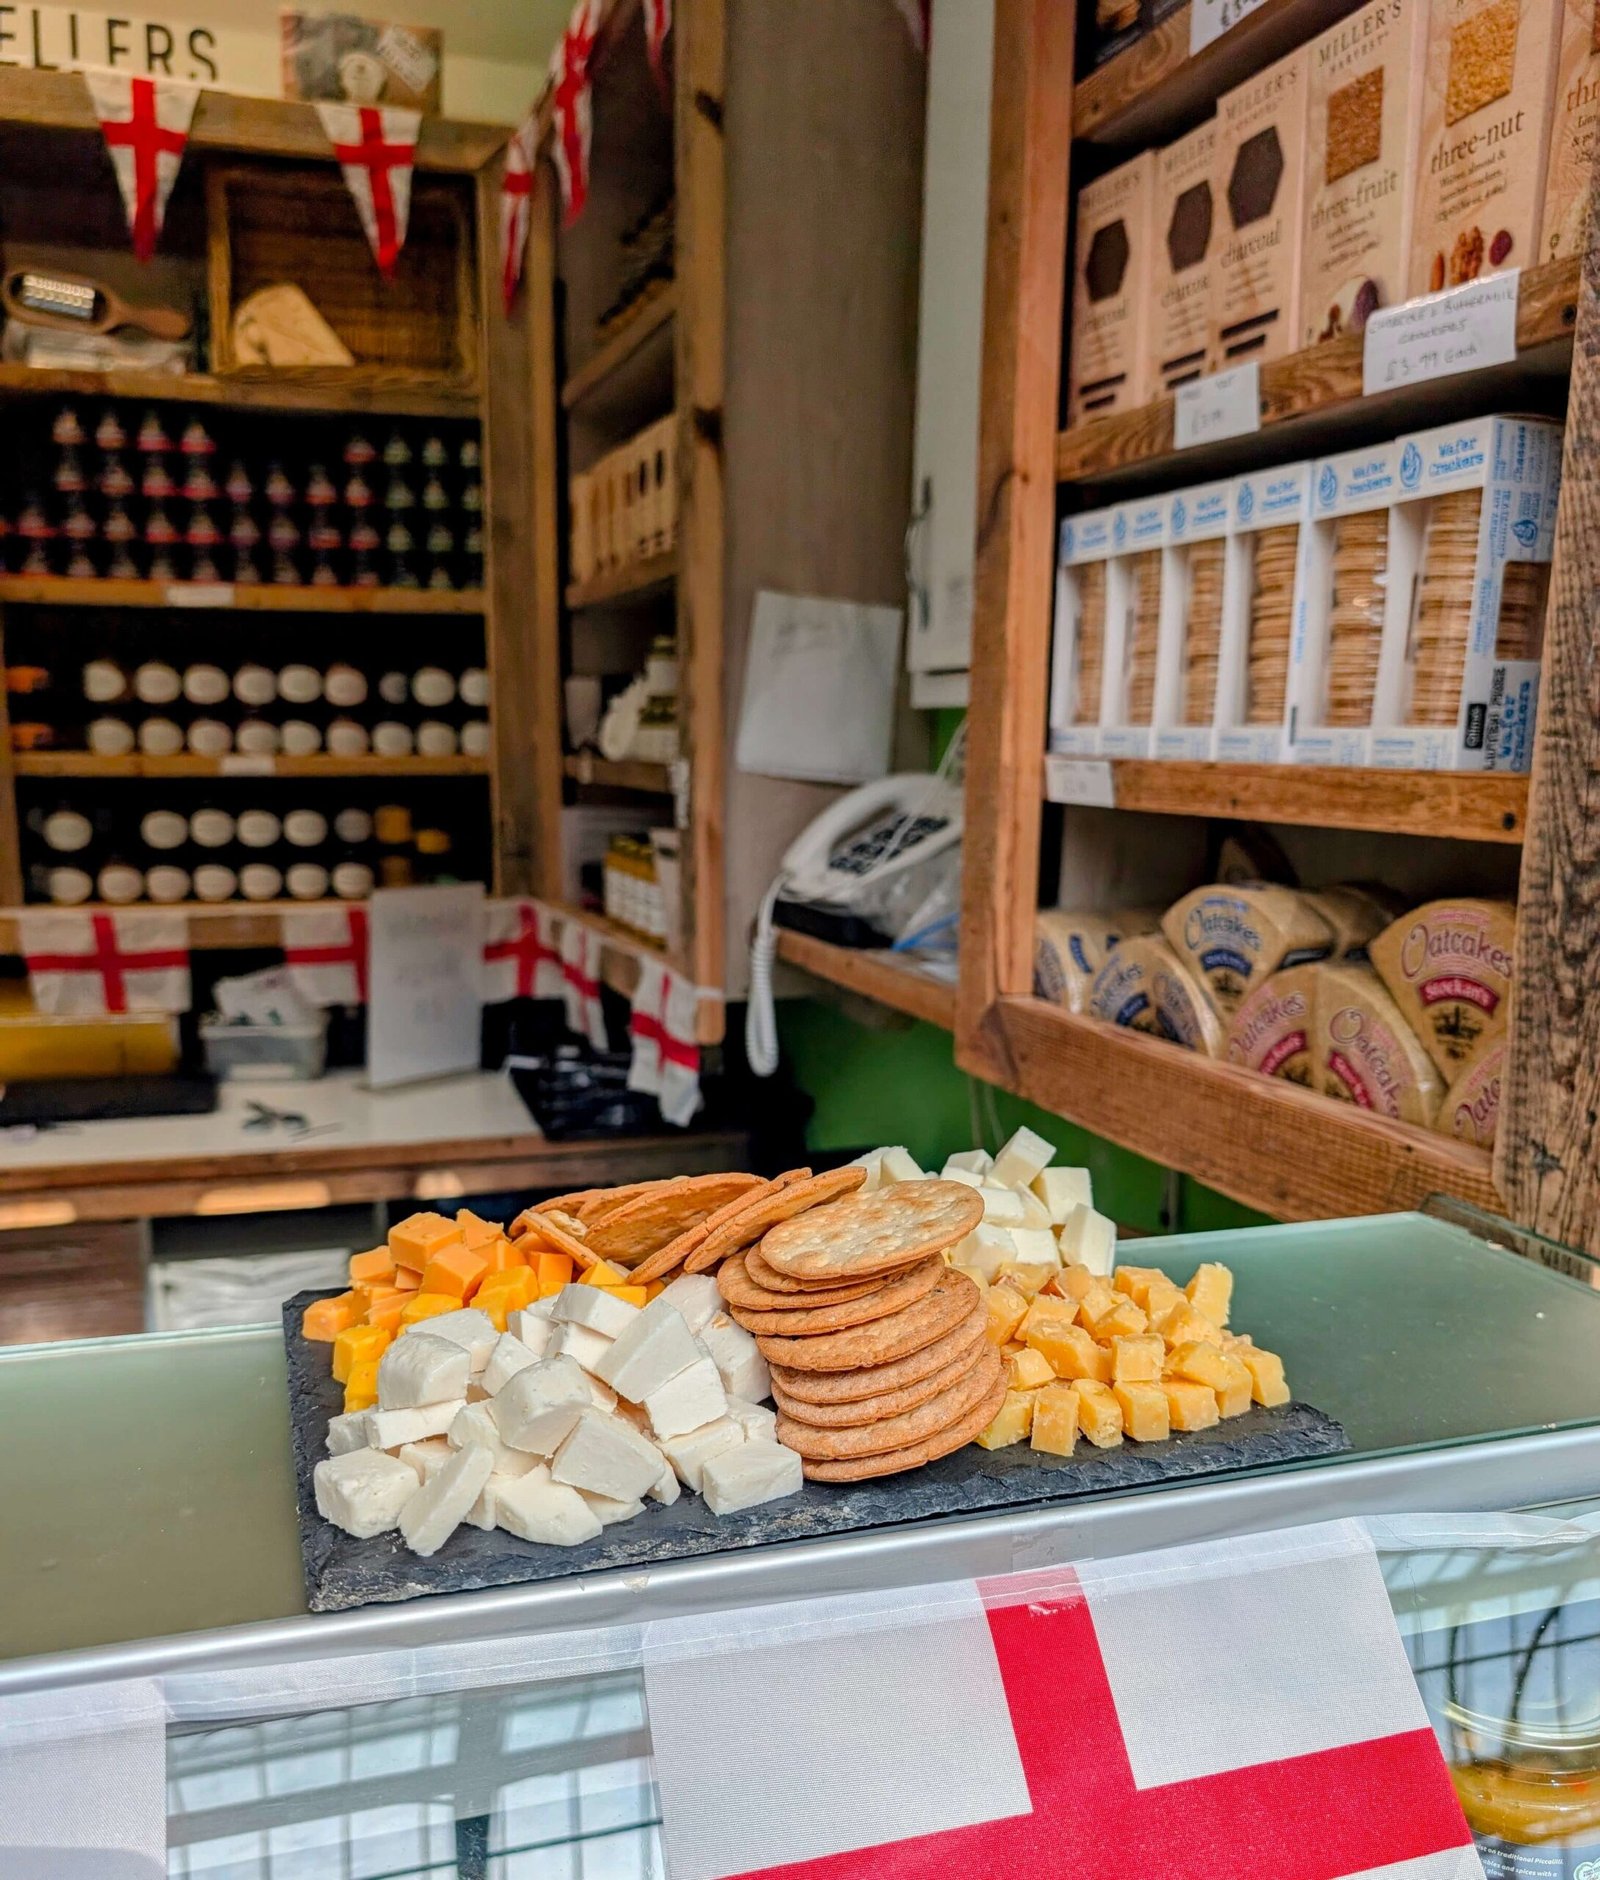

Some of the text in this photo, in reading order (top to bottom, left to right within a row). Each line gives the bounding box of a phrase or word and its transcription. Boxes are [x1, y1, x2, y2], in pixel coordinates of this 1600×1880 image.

[1430, 109, 1525, 174] three-nut
[1438, 437, 1477, 458] Wafer
[1430, 453, 1484, 477] Crackers
[1401, 923, 1513, 979] Oatcakes
[1497, 1850, 1534, 1864] traditional
[1501, 1865, 1515, 1873] and
[1515, 1868, 1536, 1877] spices
[1537, 1869, 1552, 1877] with
